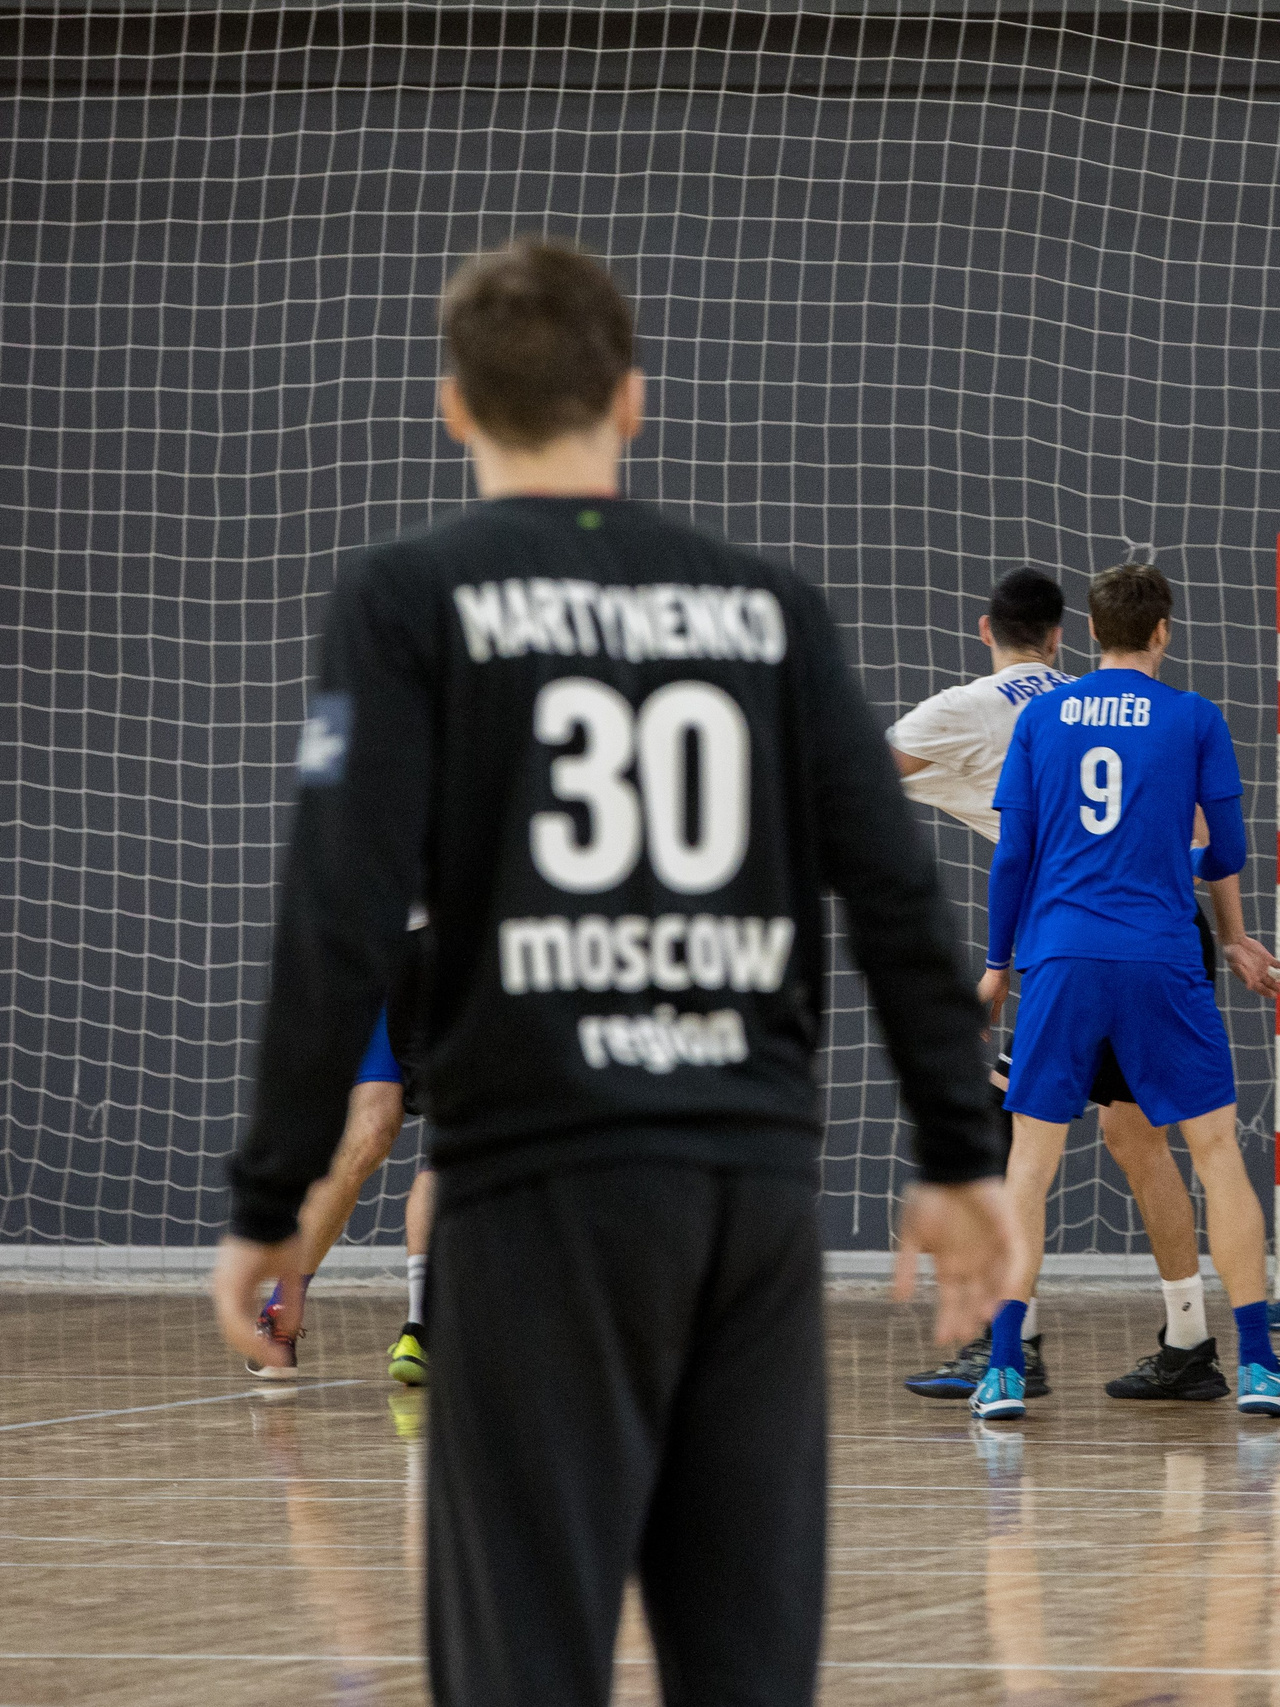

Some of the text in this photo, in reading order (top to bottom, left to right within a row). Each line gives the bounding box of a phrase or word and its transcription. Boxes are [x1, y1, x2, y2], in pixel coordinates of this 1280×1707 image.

[996, 671, 1078, 706] ИБРА
[1060, 693, 1150, 727] ФИЛЁВ
[530, 677, 750, 893] 30
[1080, 746, 1122, 835] 9
